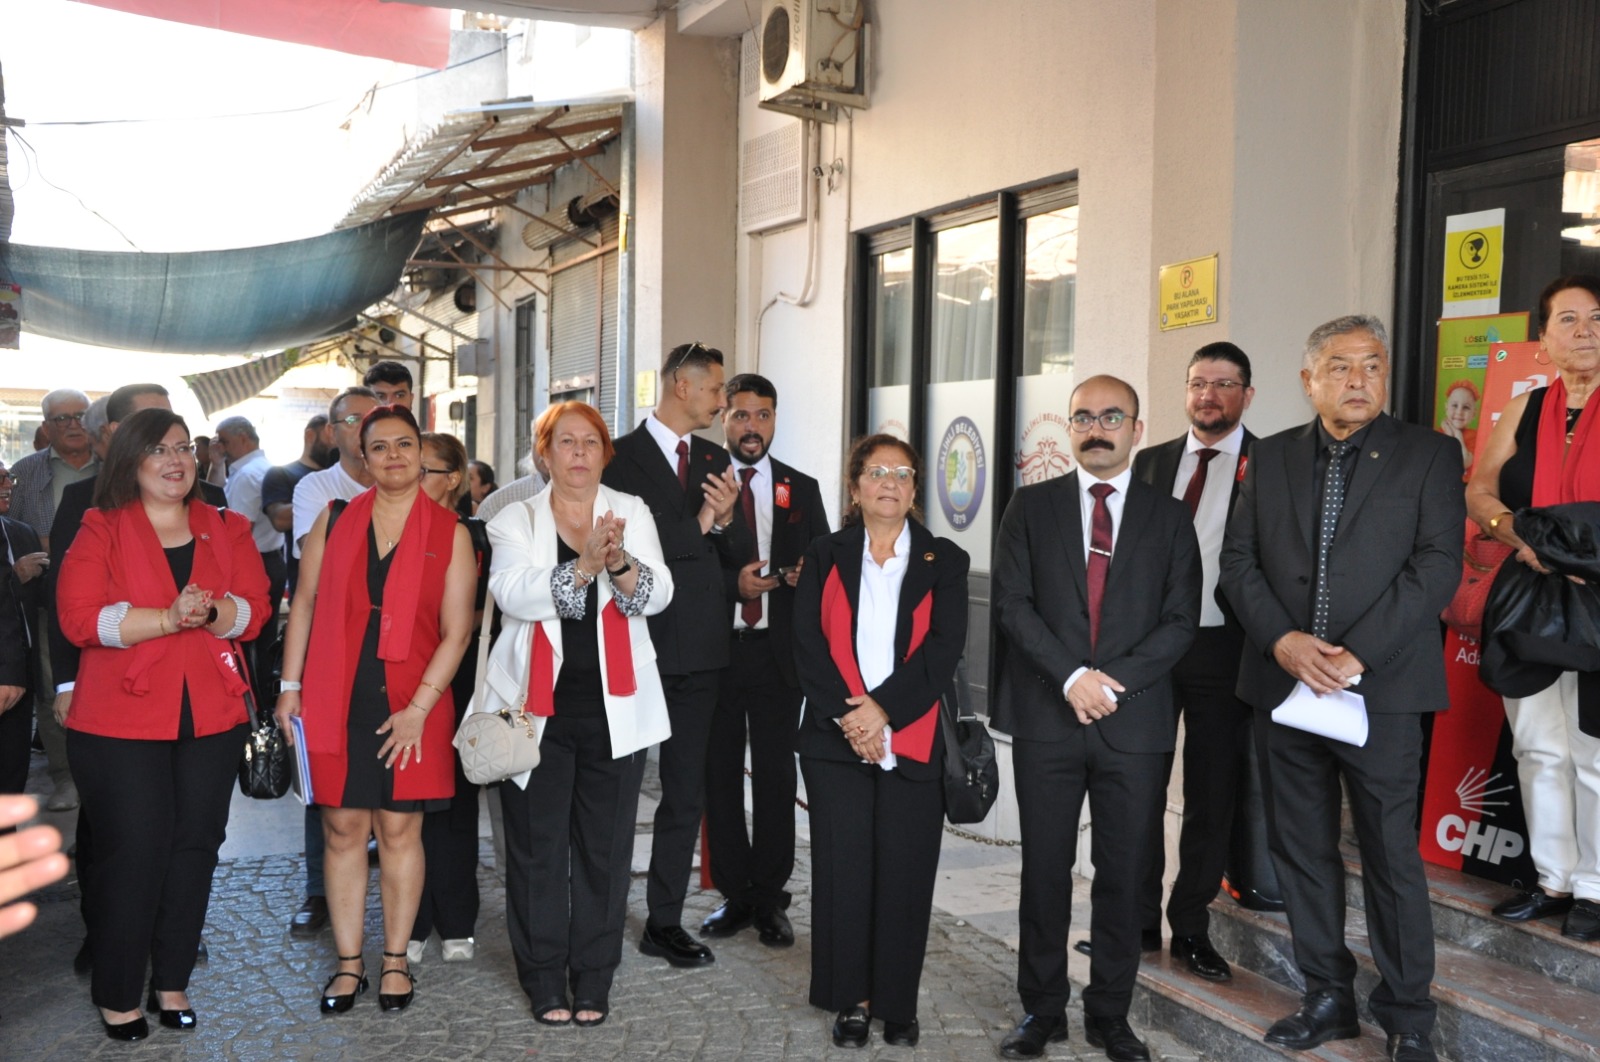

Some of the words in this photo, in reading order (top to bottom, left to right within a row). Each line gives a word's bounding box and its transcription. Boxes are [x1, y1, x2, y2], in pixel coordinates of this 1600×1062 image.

[1174, 292, 1181, 300] BU
[1182, 288, 1199, 298] ALANA
[1166, 302, 1179, 311] PARK
[1180, 297, 1208, 308] YAPILMASI
[1174, 308, 1199, 319] YASAKTIR
[1436, 813, 1524, 866] CHP
